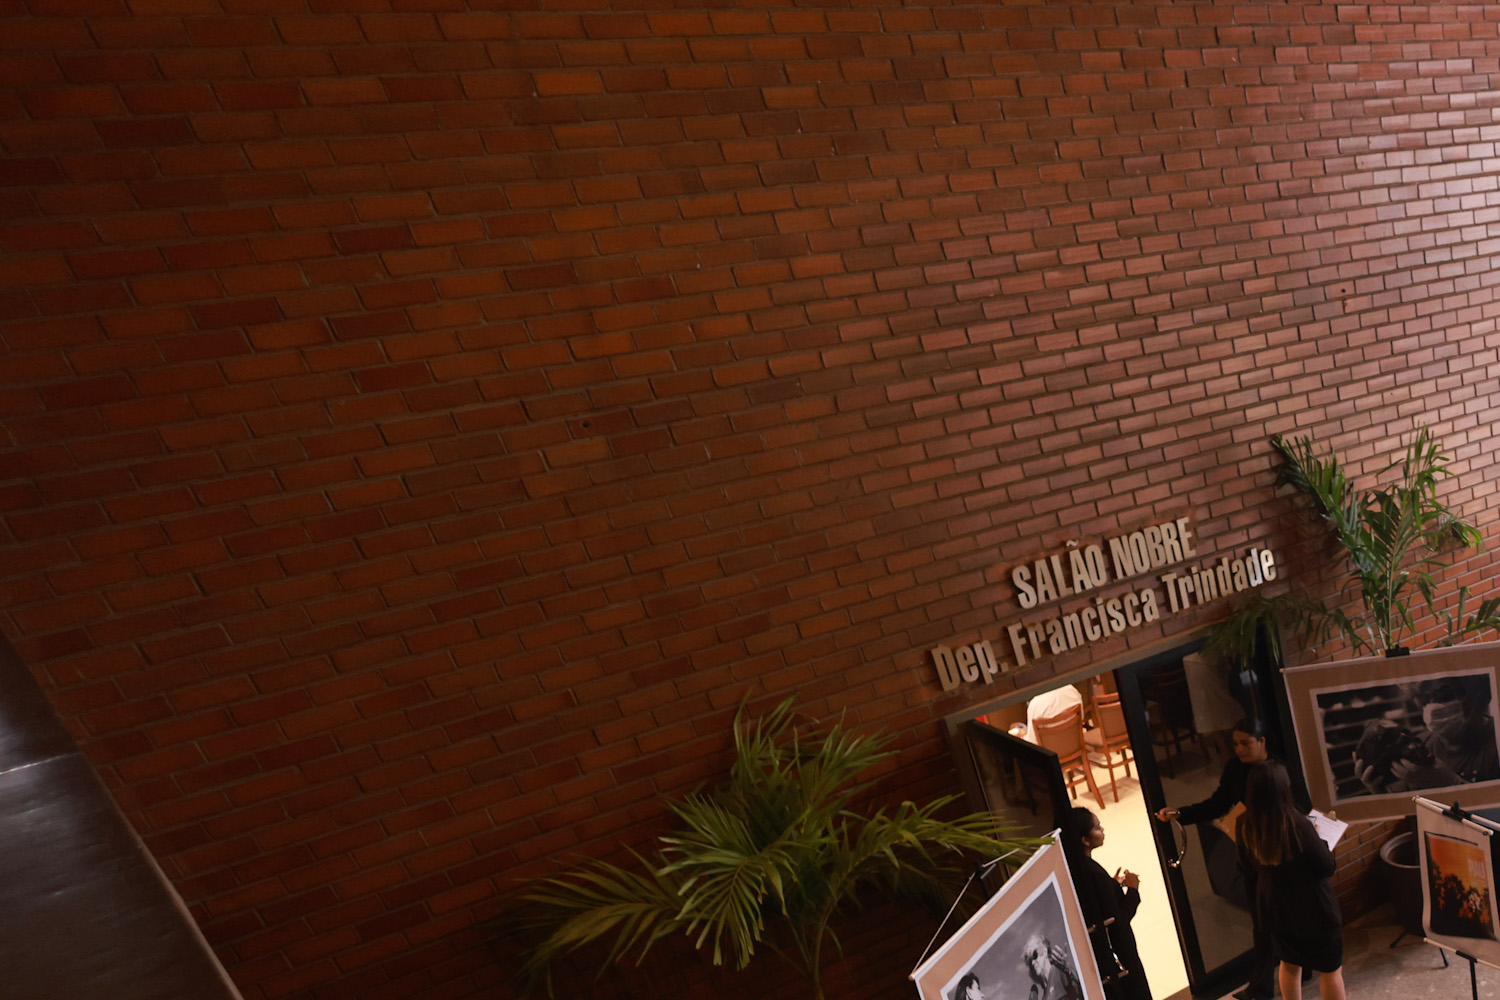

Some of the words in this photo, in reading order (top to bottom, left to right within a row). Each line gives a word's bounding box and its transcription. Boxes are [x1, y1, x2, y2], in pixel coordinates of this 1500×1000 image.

[931, 639, 1009, 692] Dep.
[1007, 587, 1160, 667] Francisca
[1161, 547, 1277, 613] Trindade
[1012, 539, 1108, 609] SALÃO
[1109, 517, 1196, 580] NOBRE
